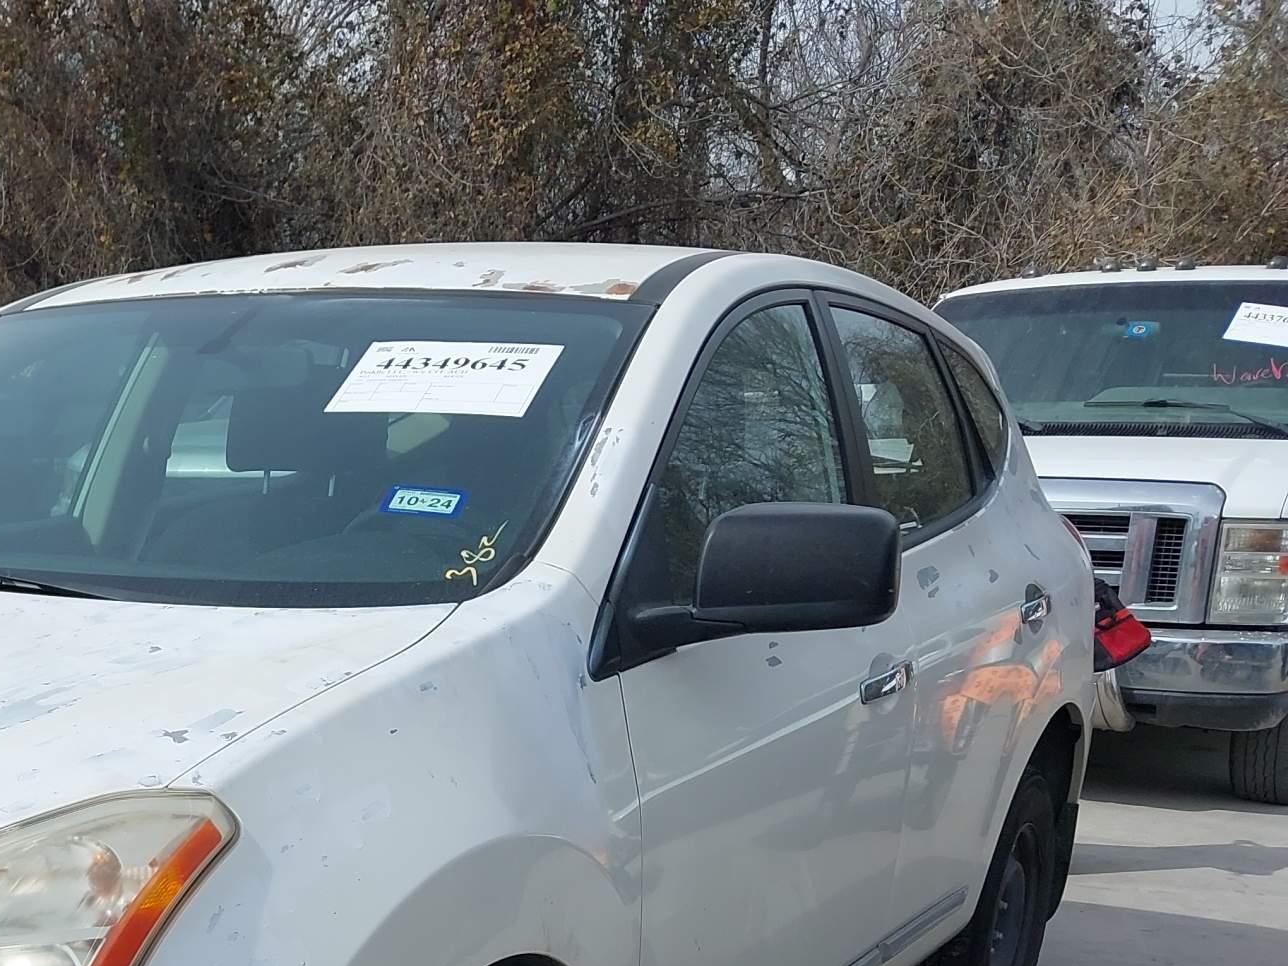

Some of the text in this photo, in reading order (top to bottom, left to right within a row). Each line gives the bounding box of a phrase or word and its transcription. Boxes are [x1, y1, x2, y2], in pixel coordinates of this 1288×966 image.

[376, 357, 530, 371] 44349645
[397, 495, 419, 506] 10
[427, 498, 453, 510] 24
